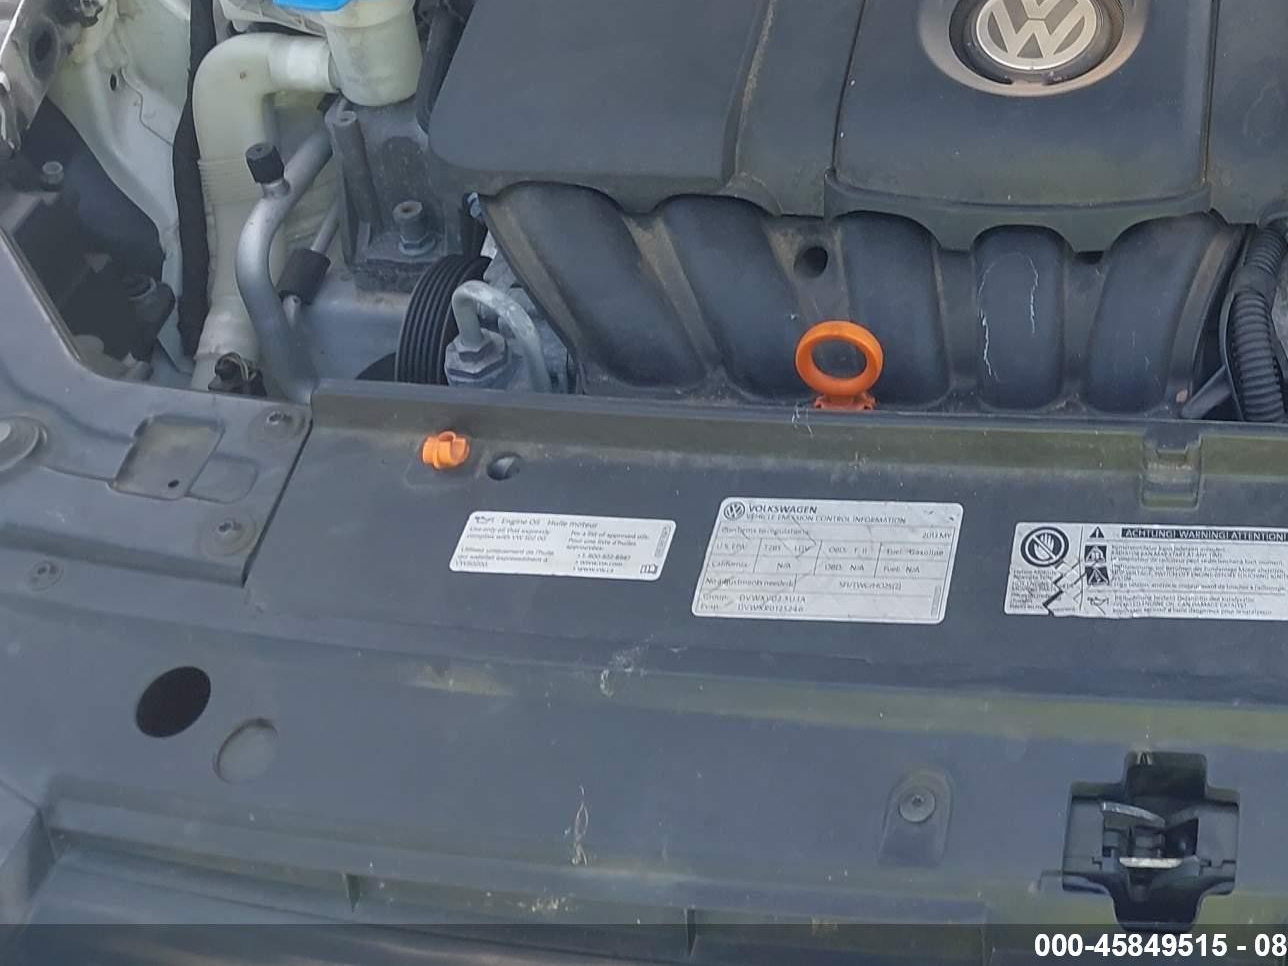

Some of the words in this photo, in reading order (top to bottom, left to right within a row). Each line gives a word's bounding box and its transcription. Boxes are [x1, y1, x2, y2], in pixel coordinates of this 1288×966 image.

[749, 504, 817, 514] VOLKSWAGEN
[1125, 529, 1176, 538] ACHTUNG!
[1179, 530, 1228, 540] WARNING!
[1230, 531, 1286, 541] ATTENTION!
